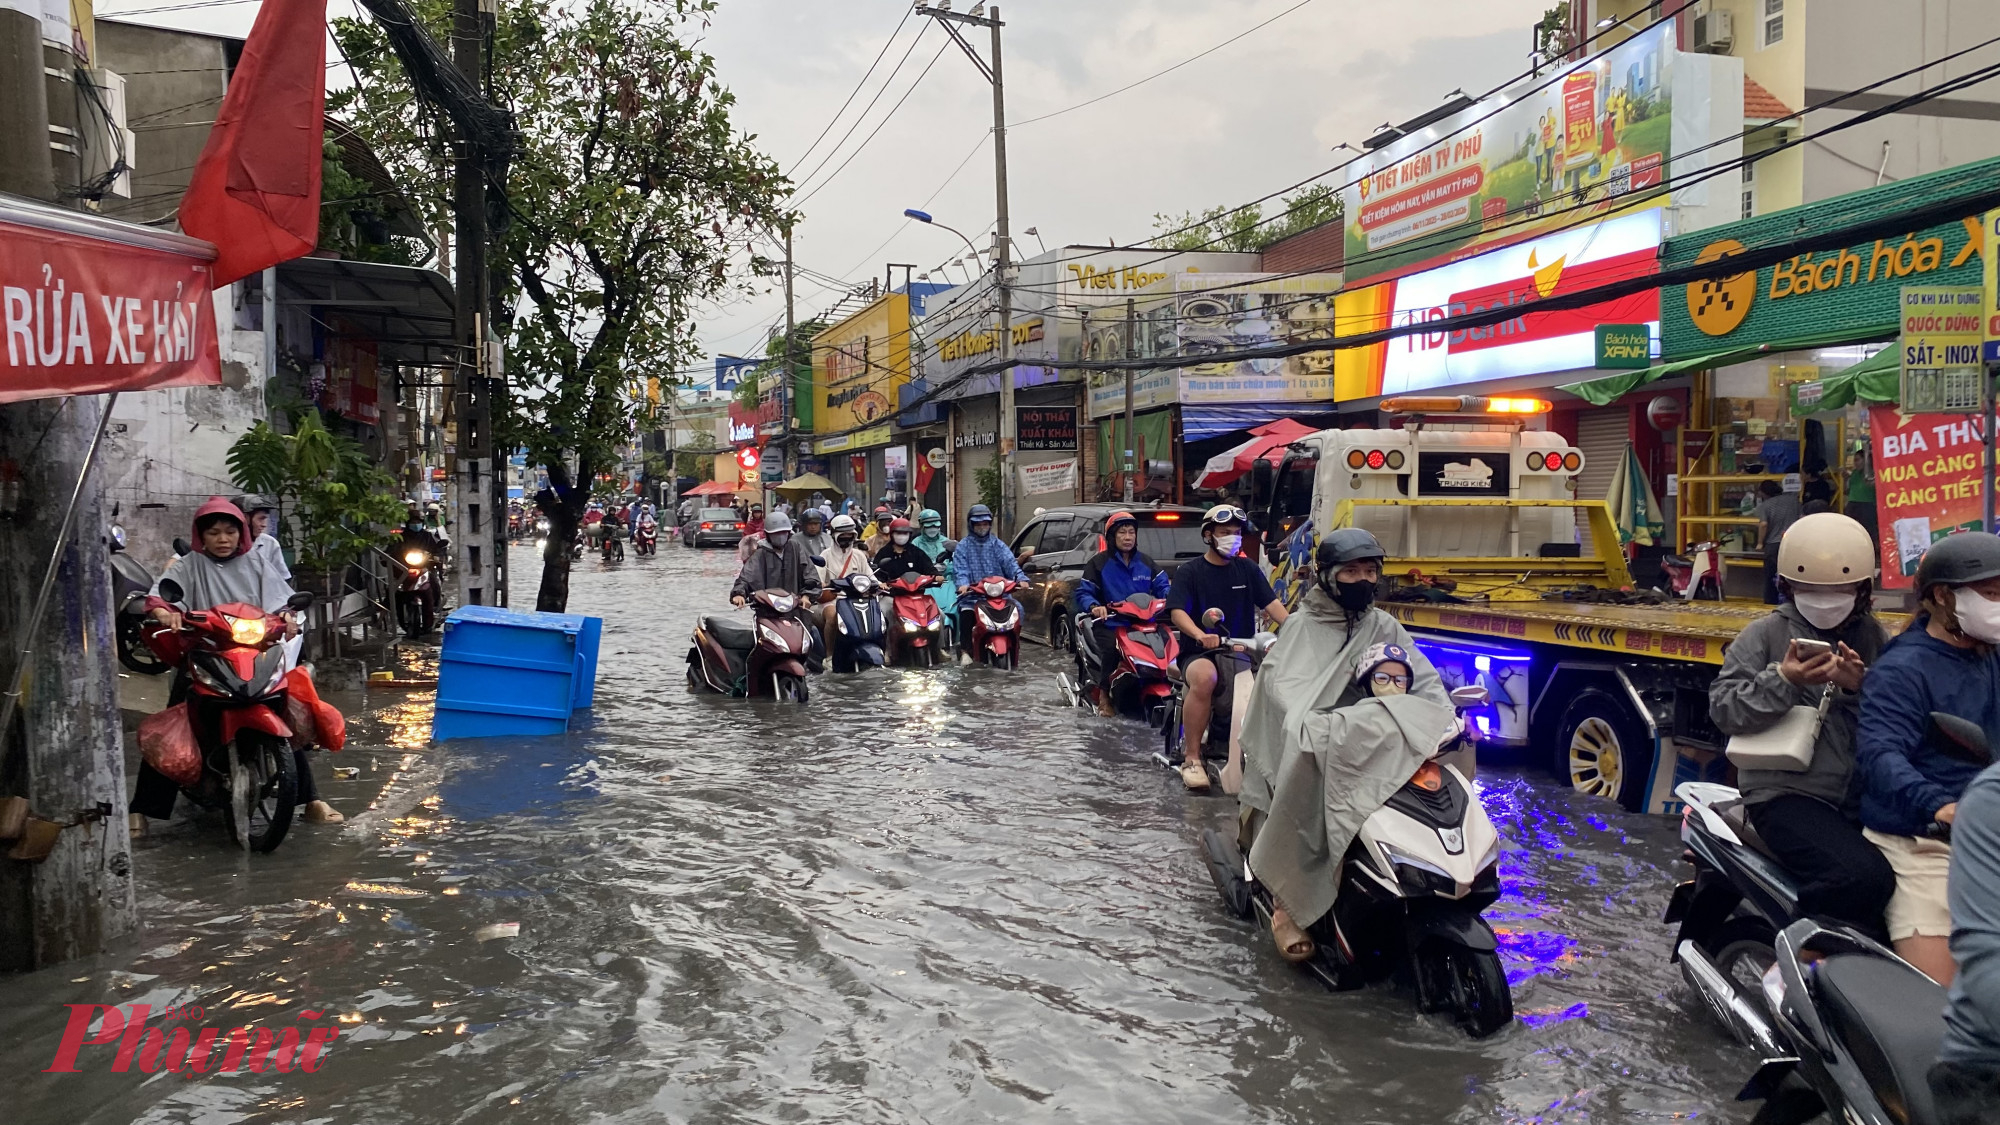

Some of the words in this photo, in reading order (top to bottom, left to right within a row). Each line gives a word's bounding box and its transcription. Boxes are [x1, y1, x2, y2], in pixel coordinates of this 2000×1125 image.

[1376, 168, 1399, 193] TIẾT
[1401, 154, 1431, 183] KIỆM
[1436, 142, 1450, 169] TỶ
[1454, 129, 1482, 163] PHÚ
[1362, 211, 1375, 225] TIẾT
[1374, 205, 1391, 221] KIỆM
[1390, 201, 1406, 216] HÔM
[1421, 192, 1436, 206] VẬN
[1436, 186, 1451, 199] MAY
[1451, 179, 1462, 192] TỶ
[1462, 173, 1478, 189] PHÚ
[1068, 264, 1116, 289] Viet
[1122, 265, 1168, 289] Hom
[1770, 248, 1861, 299] Bách
[1867, 232, 1943, 282] hóa
[1906, 293, 1919, 305] CƠ
[4, 263, 93, 366] RỬA
[102, 295, 146, 364] XE
[152, 281, 197, 362] HẢI
[1906, 310, 1942, 333] QUỐC
[1945, 313, 1979, 332] DŨNG
[1605, 333, 1629, 345] Bách
[1630, 334, 1648, 345] hóa
[1603, 346, 1648, 358] XANH
[1907, 339, 1934, 365] SẮT
[1945, 345, 1979, 364] INOX
[722, 365, 757, 384] AC
[1188, 380, 1207, 391] Mua
[1266, 379, 1289, 390] motor
[1321, 378, 1326, 387] 3
[1023, 411, 1043, 424] NỘI
[1045, 410, 1070, 422] THẤT
[956, 432, 964, 448] CÀ
[964, 431, 975, 447] PHÊ
[1021, 425, 1045, 438] XUẤT
[1048, 425, 1074, 438] KHẨU
[1020, 440, 1035, 448] Thiết
[1049, 440, 1060, 448] Sản
[1062, 440, 1075, 448] Xuất
[1883, 430, 1928, 459] BIA
[1879, 463, 1919, 484] MUA
[1922, 454, 1976, 477] CÀNG
[1886, 487, 1938, 508] CÀNG
[1941, 475, 1983, 501] TIẾT
